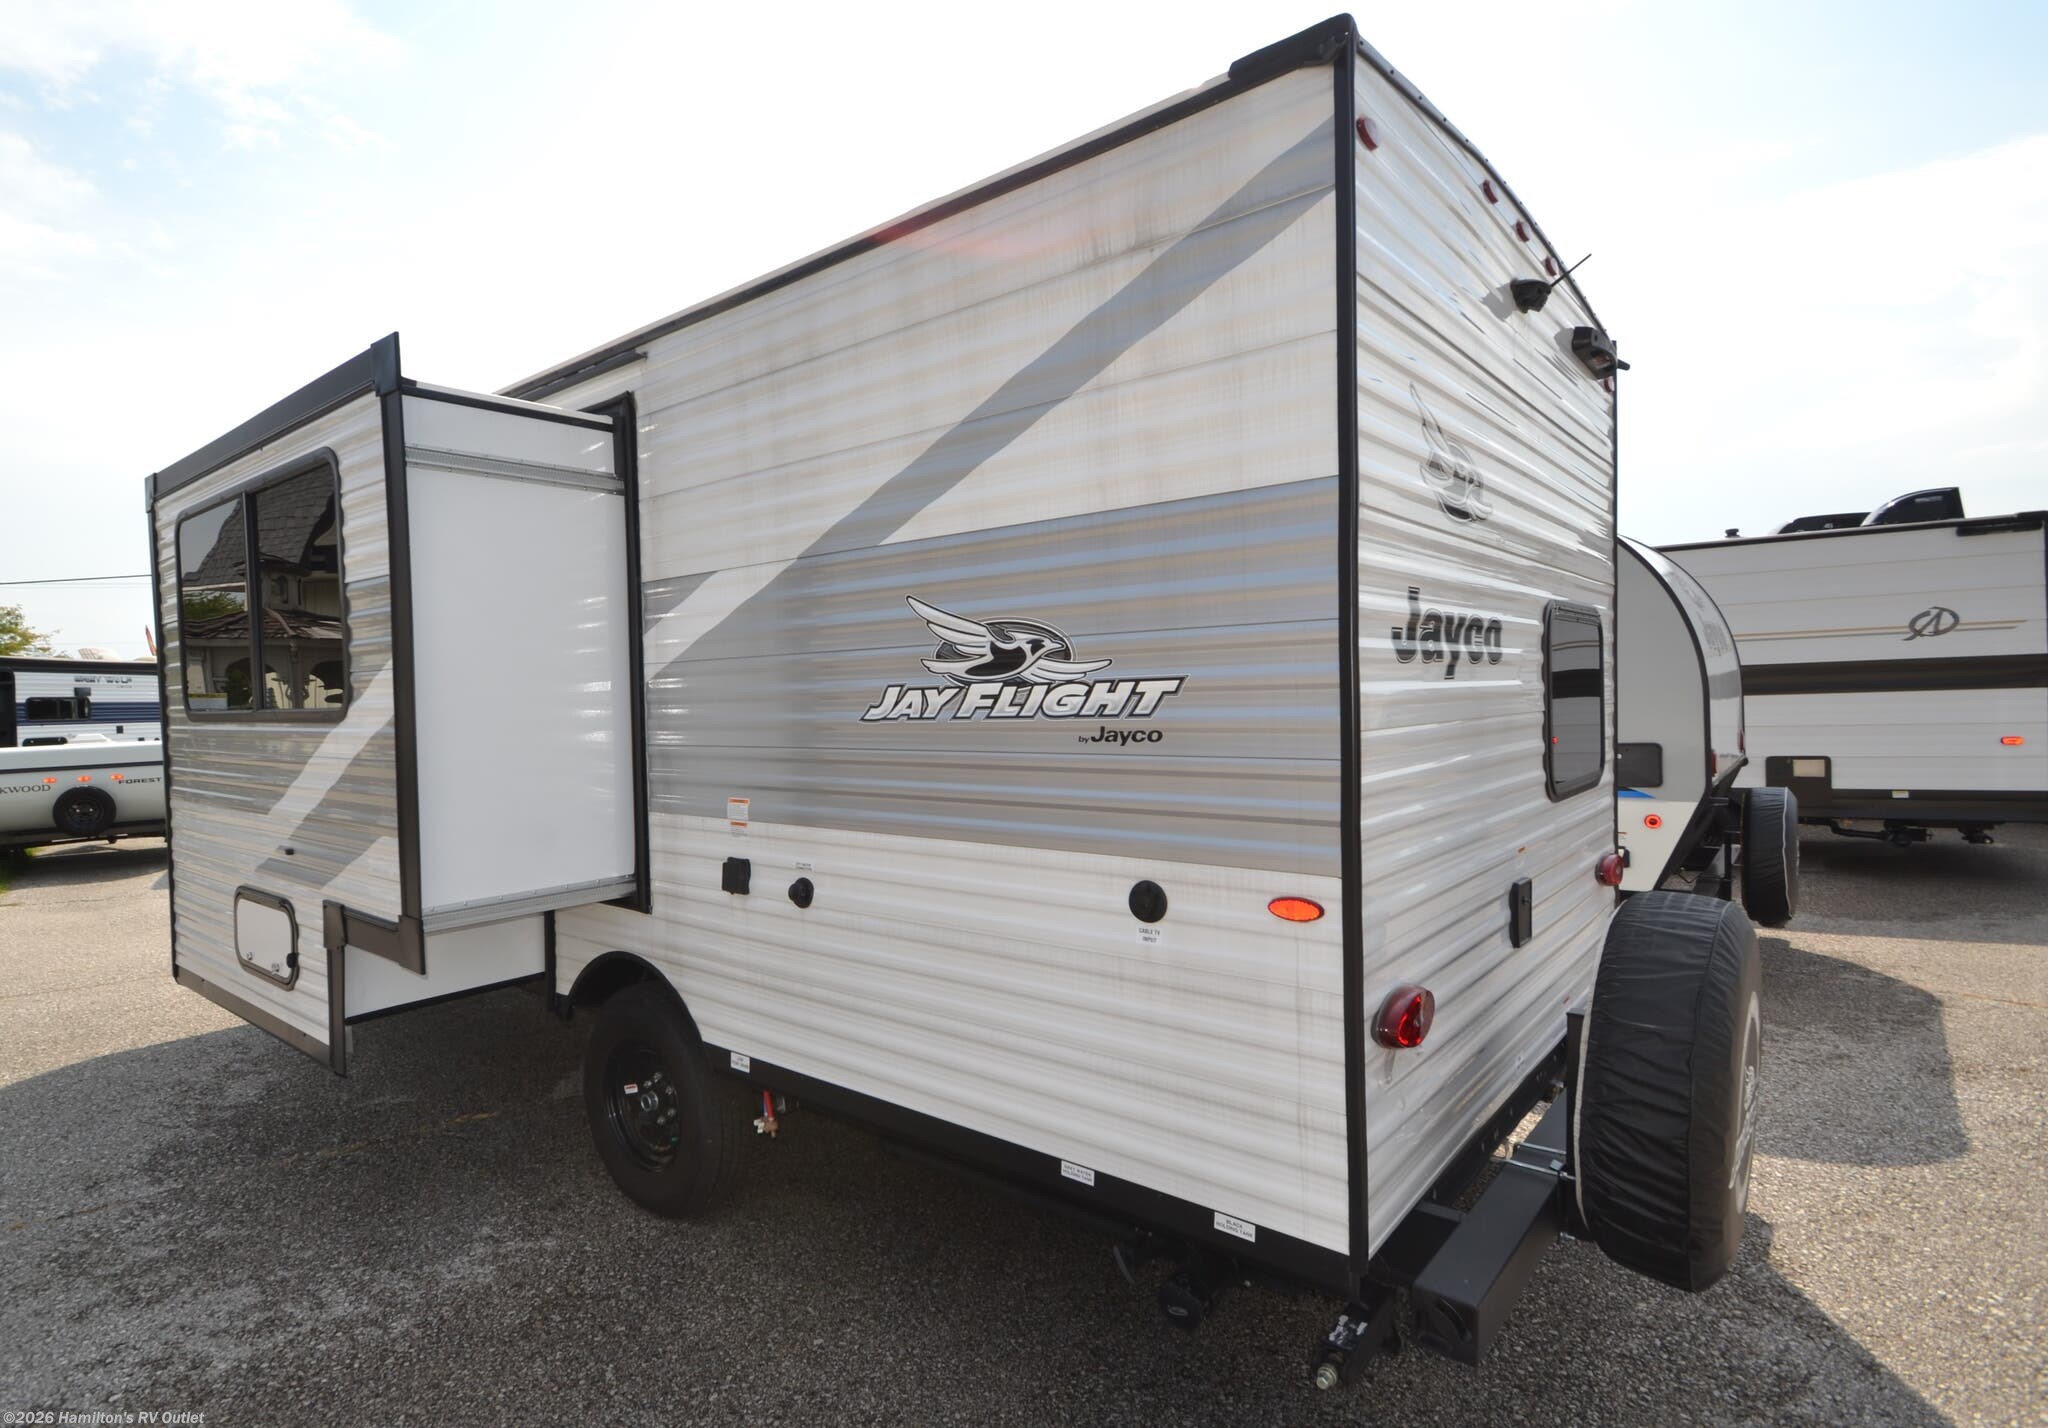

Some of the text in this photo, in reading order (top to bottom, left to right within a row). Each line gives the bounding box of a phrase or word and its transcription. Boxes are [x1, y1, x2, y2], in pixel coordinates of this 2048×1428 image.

[1391, 586, 1503, 680] Jayco
[860, 675, 1189, 722] JAY FLIGHT
[1078, 726, 1163, 747] by Jayco
[118, 776, 162, 785] FOREST
[0, 784, 51, 795] KWOOD
[1138, 927, 1153, 935] CABLE
[1215, 1221, 1238, 1233] HOLDING
[1226, 1219, 1243, 1228] BLACK
